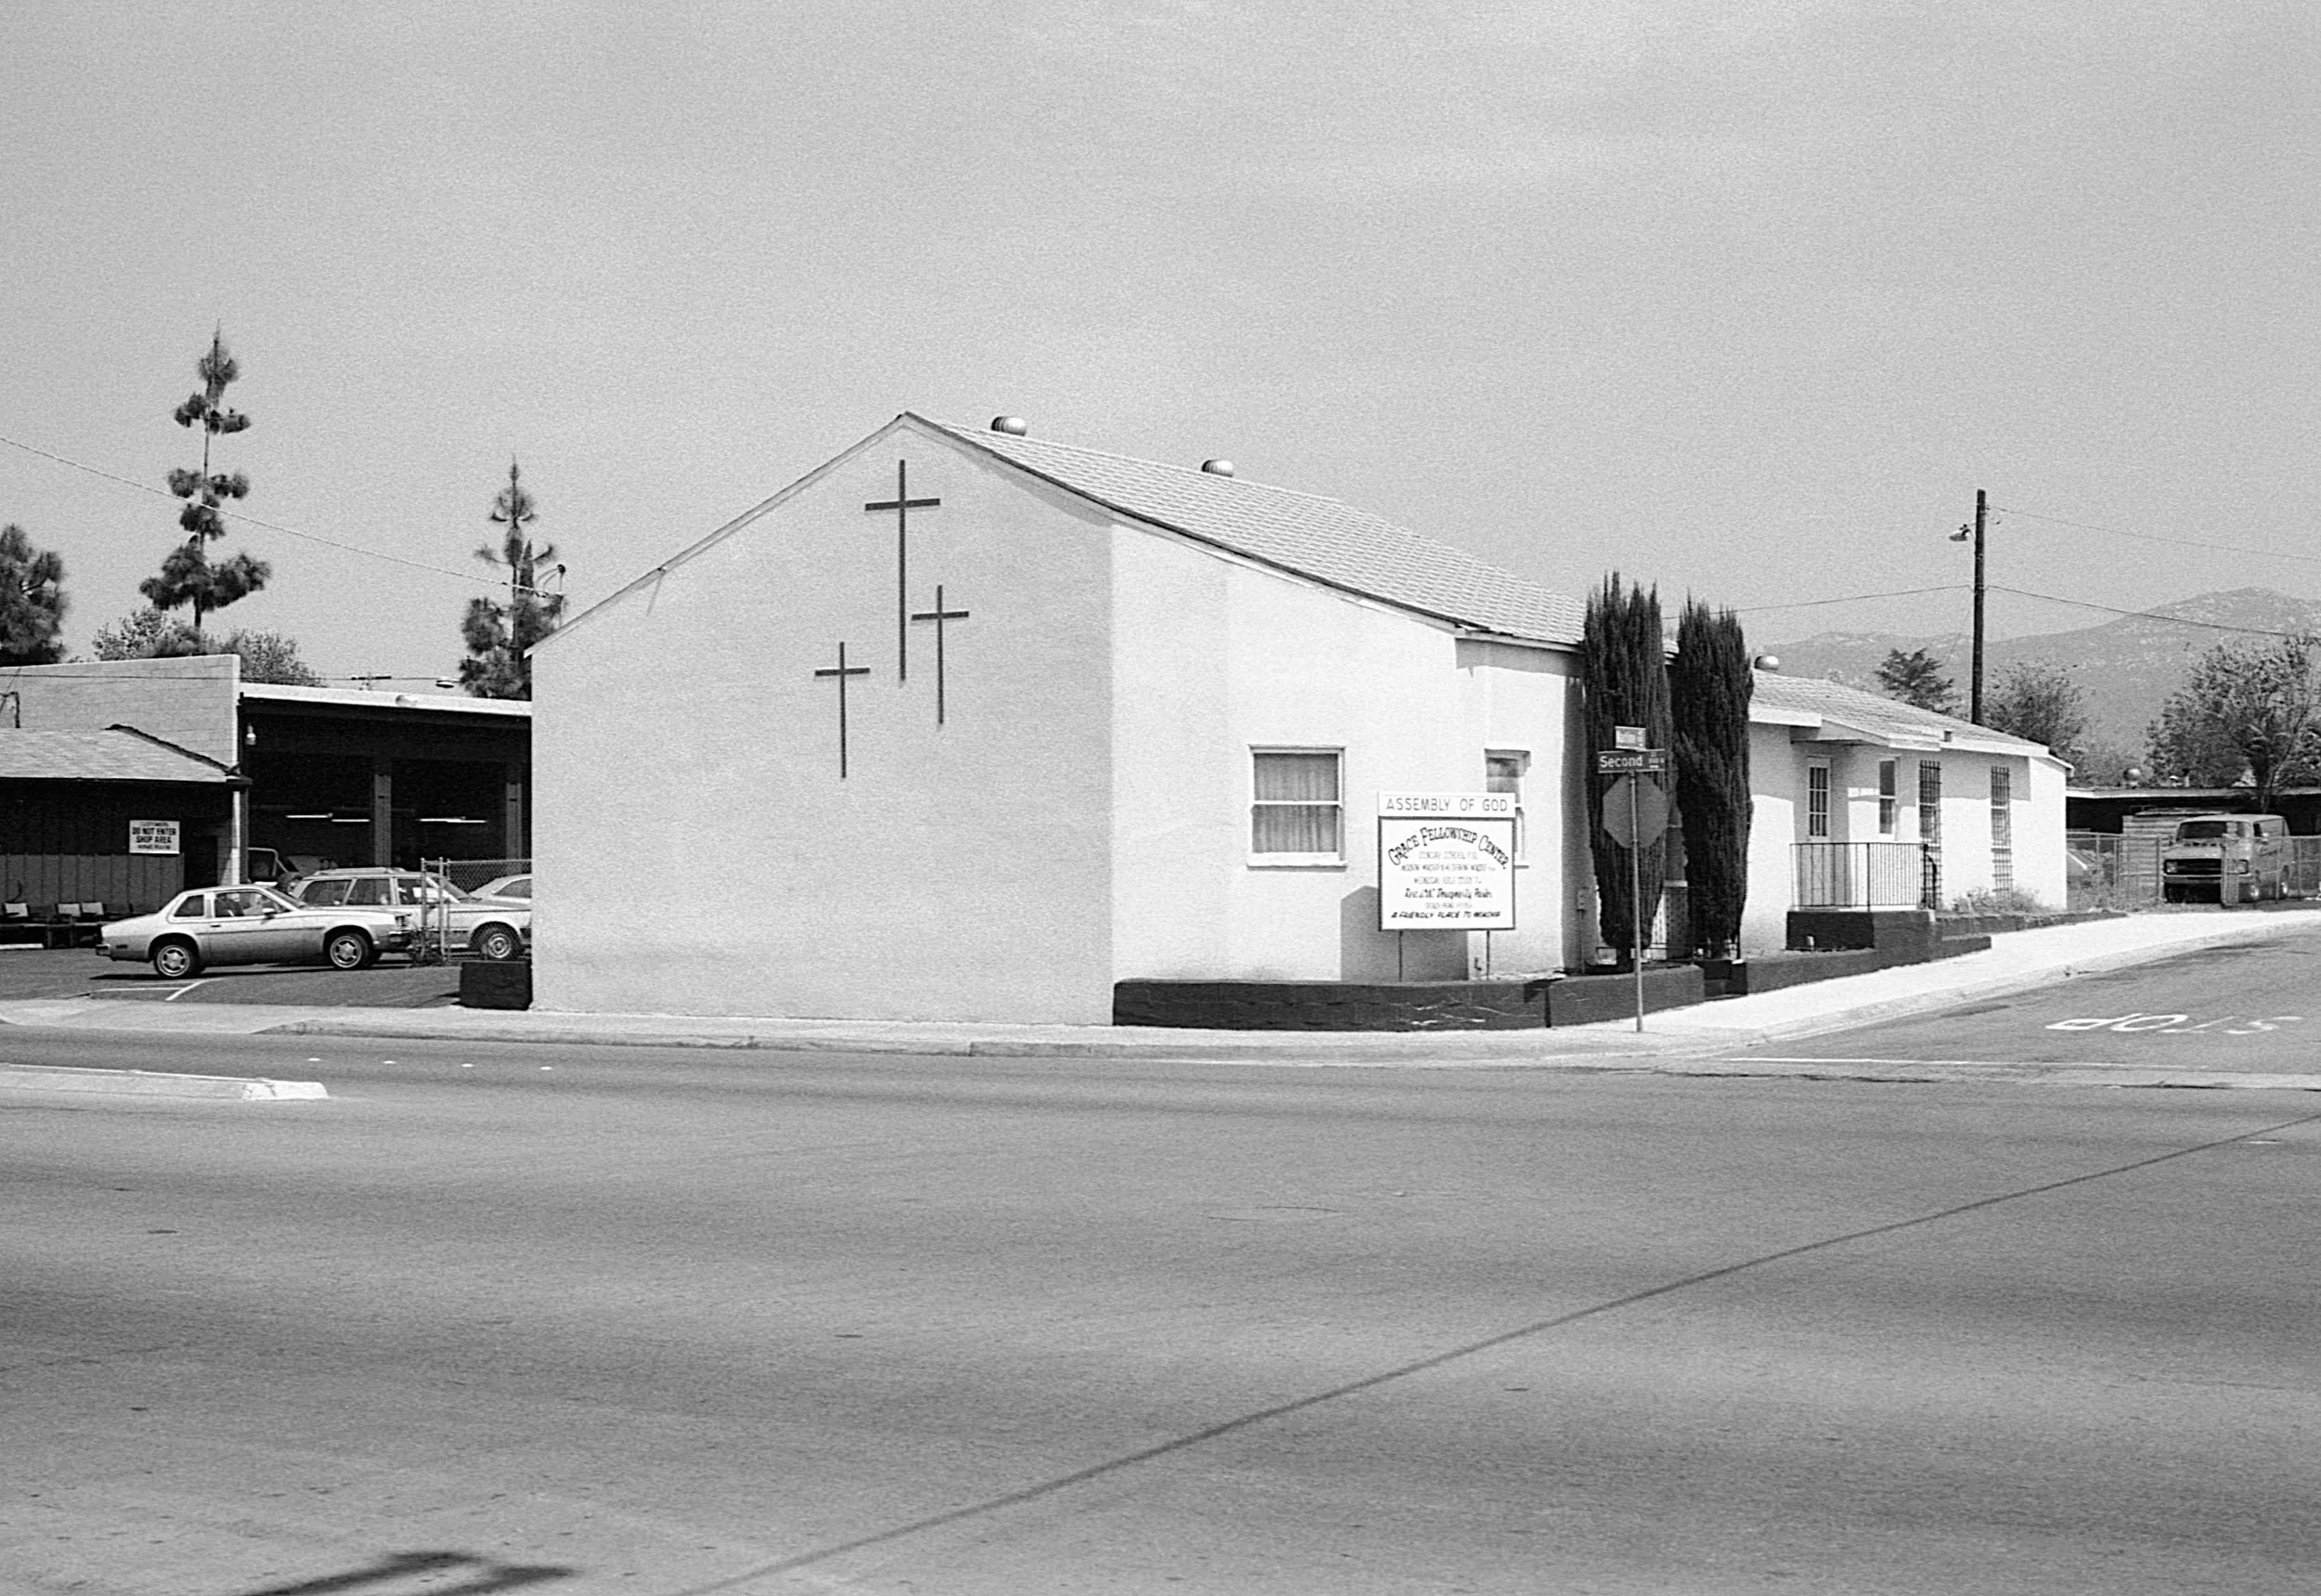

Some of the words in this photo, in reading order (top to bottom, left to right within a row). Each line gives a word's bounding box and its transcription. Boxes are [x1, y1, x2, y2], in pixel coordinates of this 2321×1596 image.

[1600, 755, 1642, 768] Second
[1386, 798, 1450, 811] ASSEMBLY
[1459, 798, 1474, 811] OF
[1483, 798, 1508, 811] GOD
[132, 826, 141, 835] DO
[142, 827, 155, 836] NOT
[156, 827, 176, 836] ENTER
[154, 836, 172, 844] AREA
[1388, 835, 1420, 865] GRACE
[1420, 827, 1478, 846] FELLOWSHIP
[2044, 1013, 2304, 1034] STOP
